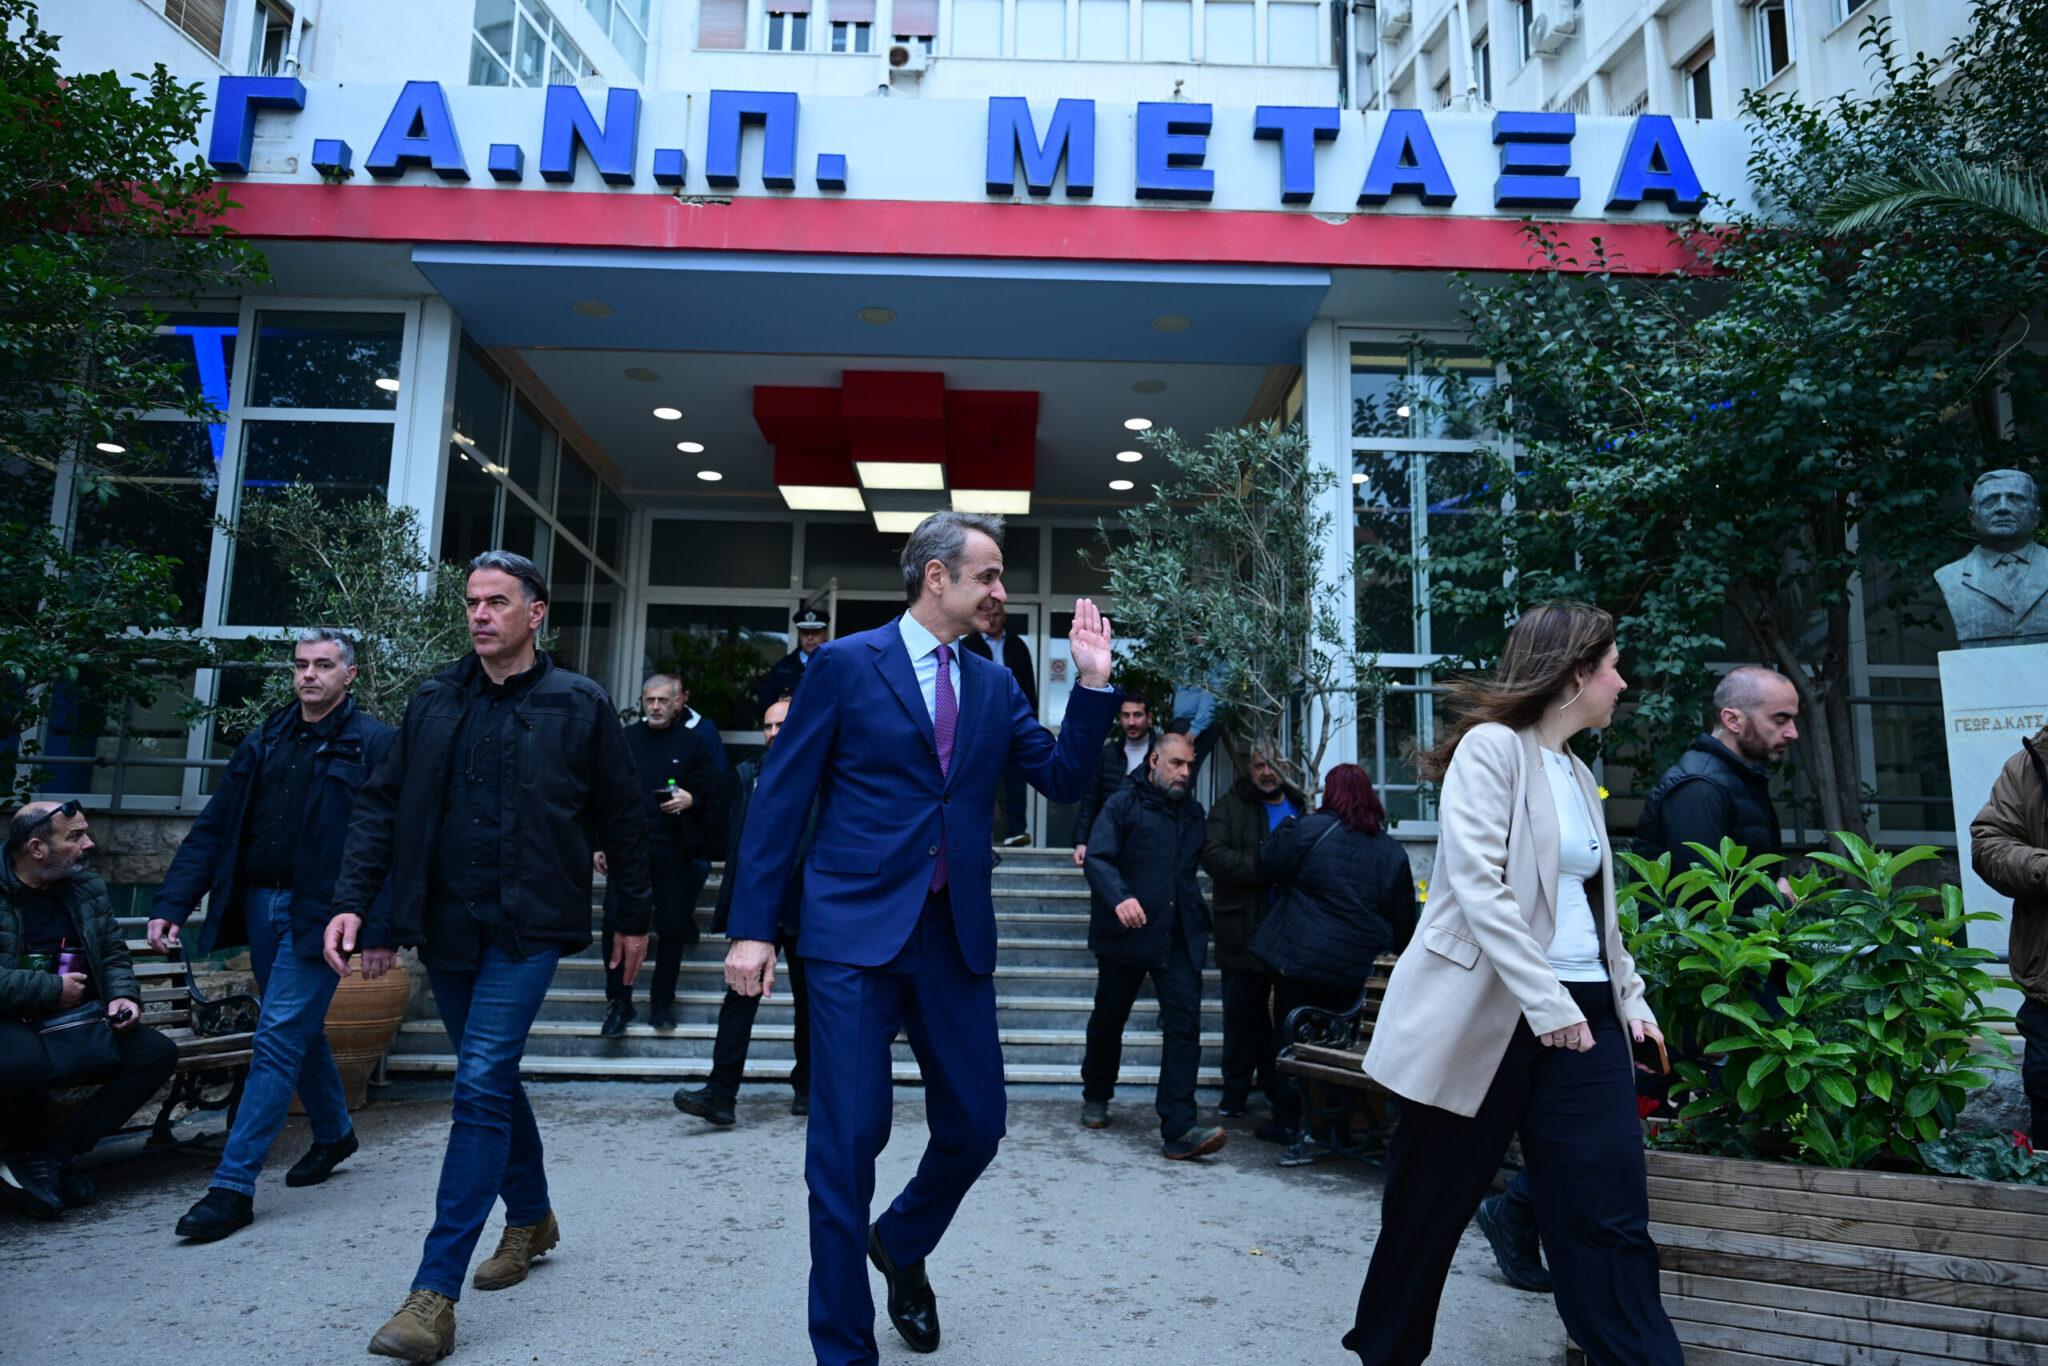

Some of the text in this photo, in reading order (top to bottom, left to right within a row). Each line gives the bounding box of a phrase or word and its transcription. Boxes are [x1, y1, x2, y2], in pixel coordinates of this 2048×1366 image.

[208, 75, 1705, 213] Γ.Α.Ν.Π. ΜΕΤΑΞΑ
[2005, 714, 2048, 730] ΚΑΤΣ
